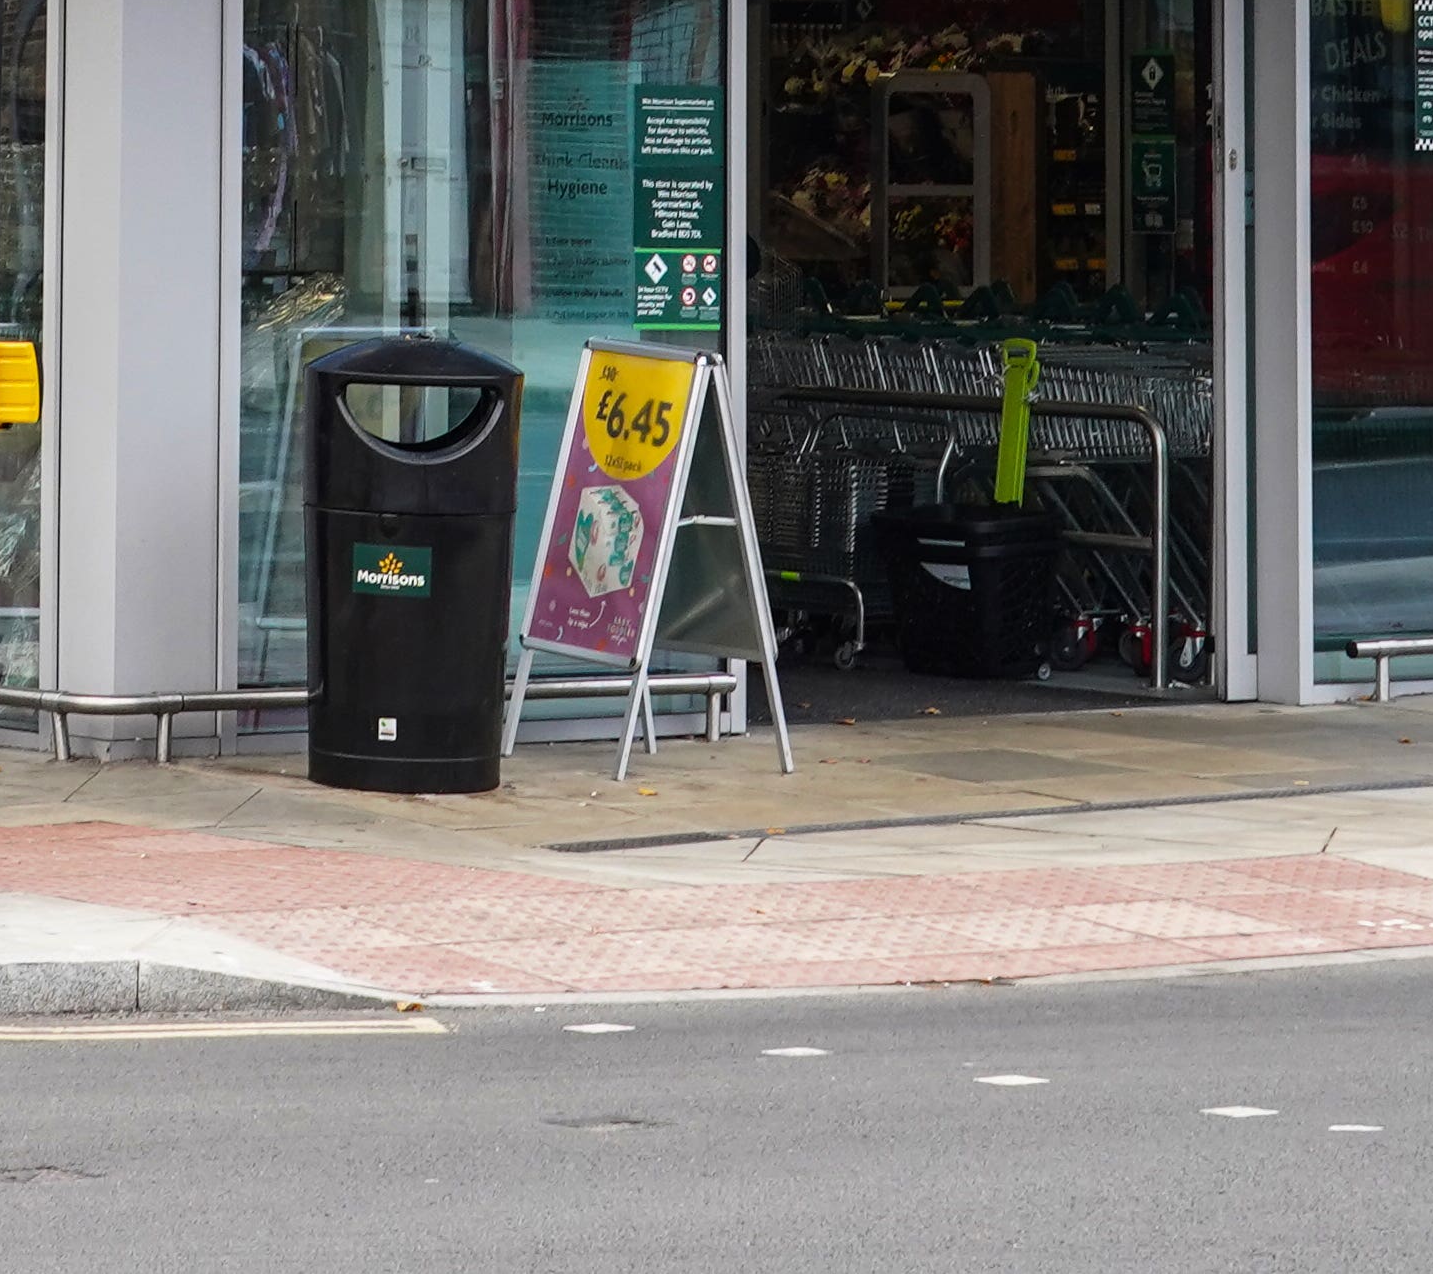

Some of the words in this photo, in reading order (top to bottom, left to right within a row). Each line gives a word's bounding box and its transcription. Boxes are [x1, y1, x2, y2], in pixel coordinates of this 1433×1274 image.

[1324, 31, 1387, 71] DEALS
[541, 112, 613, 128] Morrisons
[547, 178, 608, 200] Hygiene
[596, 389, 674, 447] £6.45
[356, 570, 425, 587] Morrisons
